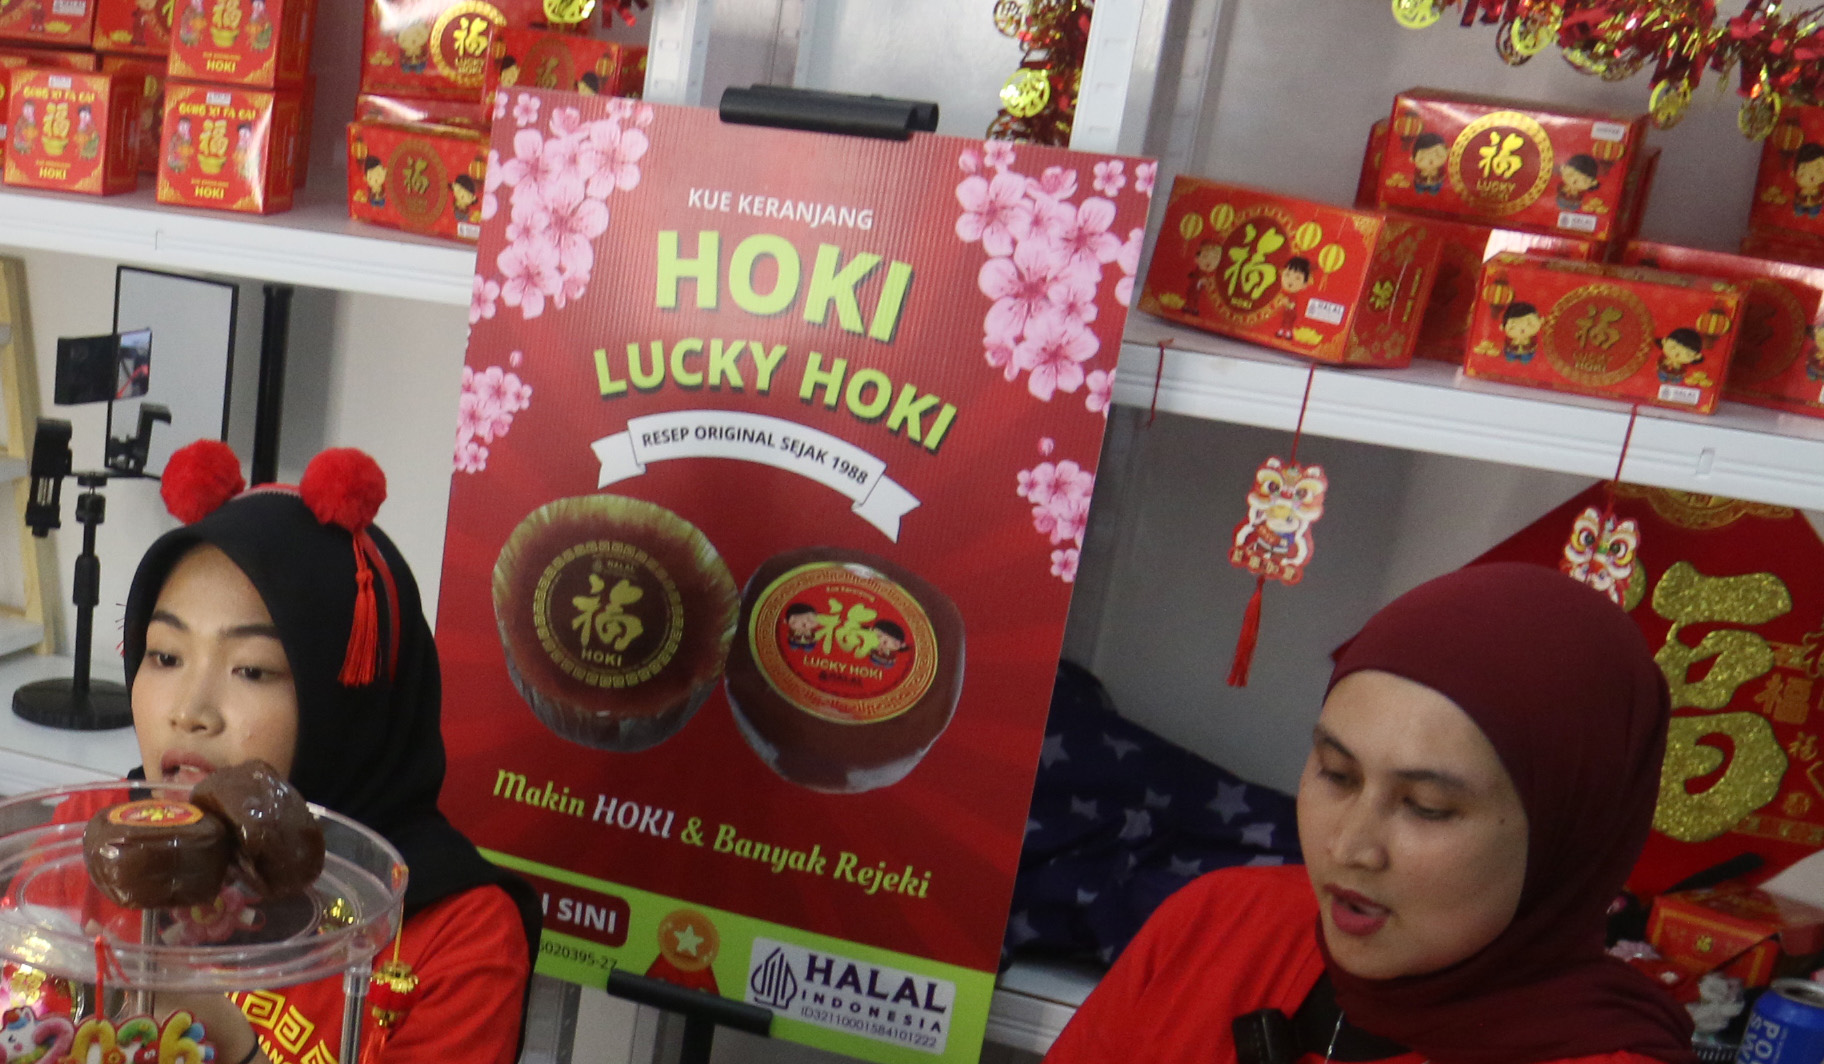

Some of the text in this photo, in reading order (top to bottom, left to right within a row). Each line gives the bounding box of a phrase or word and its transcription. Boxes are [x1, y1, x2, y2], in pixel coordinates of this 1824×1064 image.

[453, 17, 489, 56] 福
[206, 60, 236, 73] HOKI
[178, 102, 256, 120] GONG XI FA CAI
[39, 167, 67, 180] HOKI
[1479, 131, 1525, 178] 福
[195, 186, 225, 199] HOKI
[687, 187, 874, 231] KUE KERANJANG
[1224, 223, 1285, 300] 福
[656, 230, 914, 343] HOKI
[594, 338, 958, 451] LUCKY HOKI
[642, 426, 869, 486] RESEP ORIGINAL SEJAK 1988
[572, 573, 644, 651] 福
[814, 598, 880, 659] 福
[581, 649, 623, 667] HOKI
[803, 655, 883, 681] LUCKY HOKI
[492, 769, 932, 899] Makin HOKI & Banyak Rejeki
[557, 897, 616, 934] SINI
[805, 953, 946, 1014] HALAL
[802, 989, 941, 1033] INDONESIA
